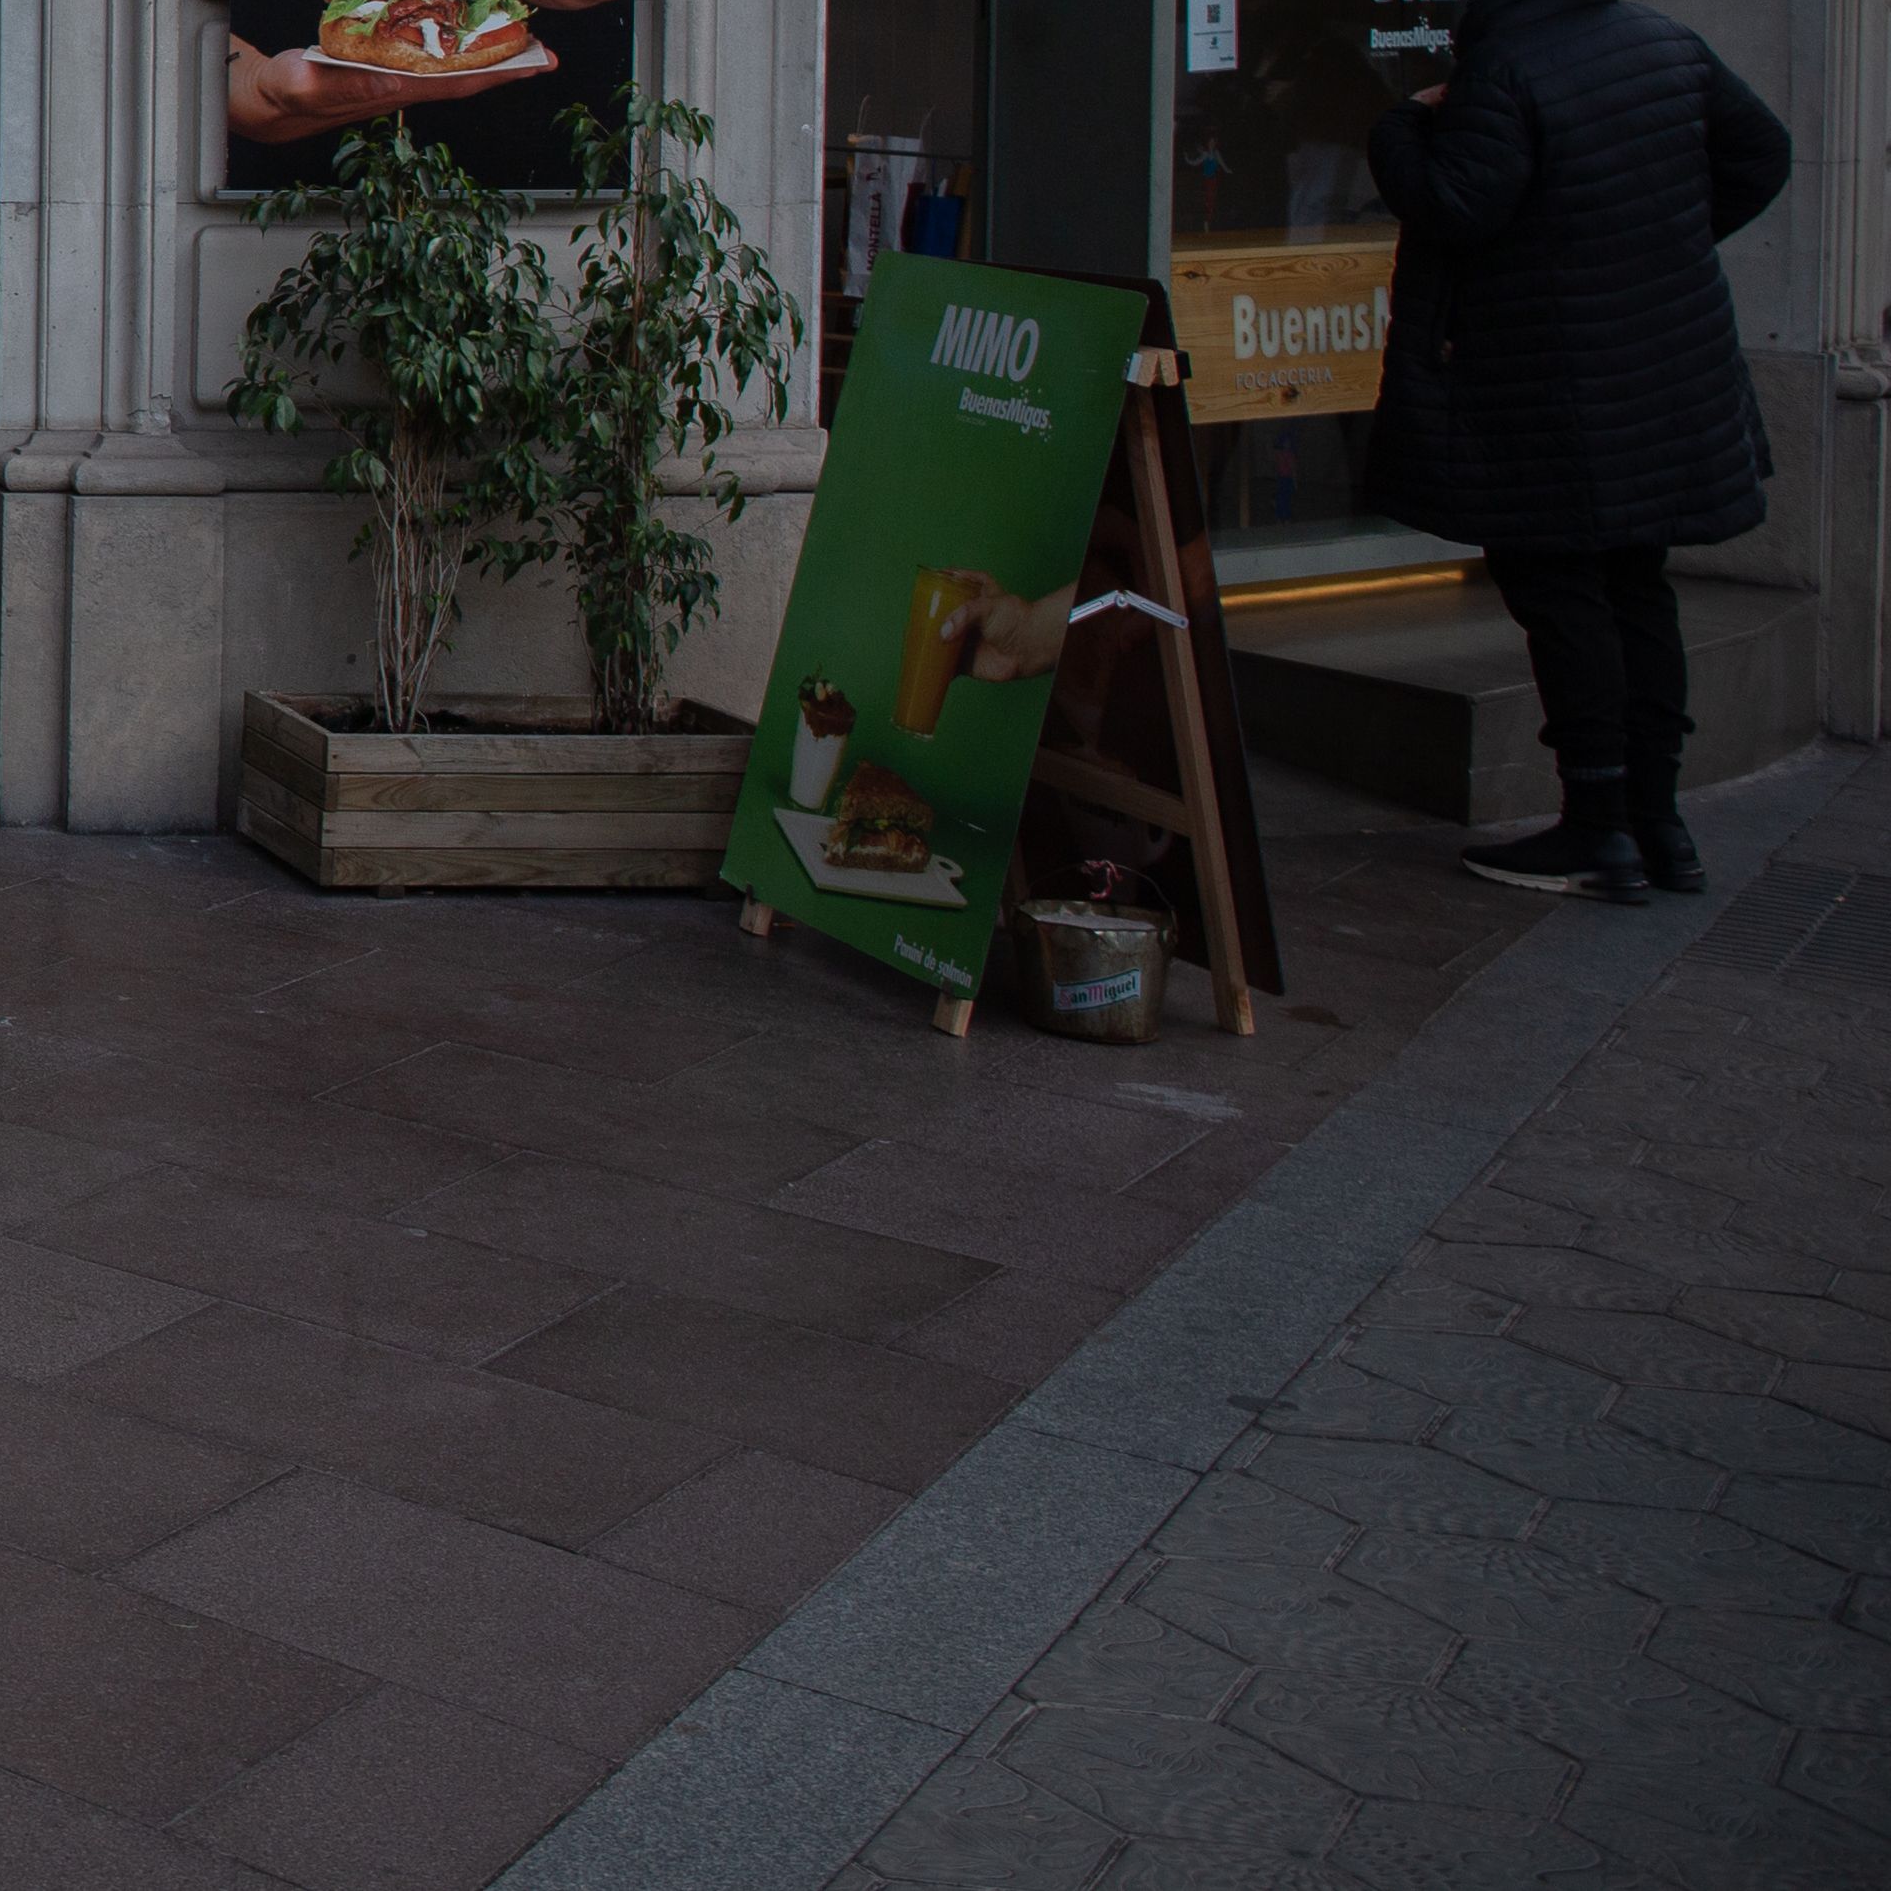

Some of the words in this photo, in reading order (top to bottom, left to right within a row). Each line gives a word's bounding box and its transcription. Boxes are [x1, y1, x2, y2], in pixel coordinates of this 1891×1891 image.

[1370, 25, 1451, 54] BuenasMigas
[930, 304, 1039, 382] MIMO
[1232, 285, 1392, 360] BuenasM
[1235, 365, 1333, 391] FOCACCERIA
[959, 386, 1051, 434] BuenasMigas
[893, 933, 924, 965] Panini
[923, 948, 936, 971] de
[937, 957, 973, 990] salmón
